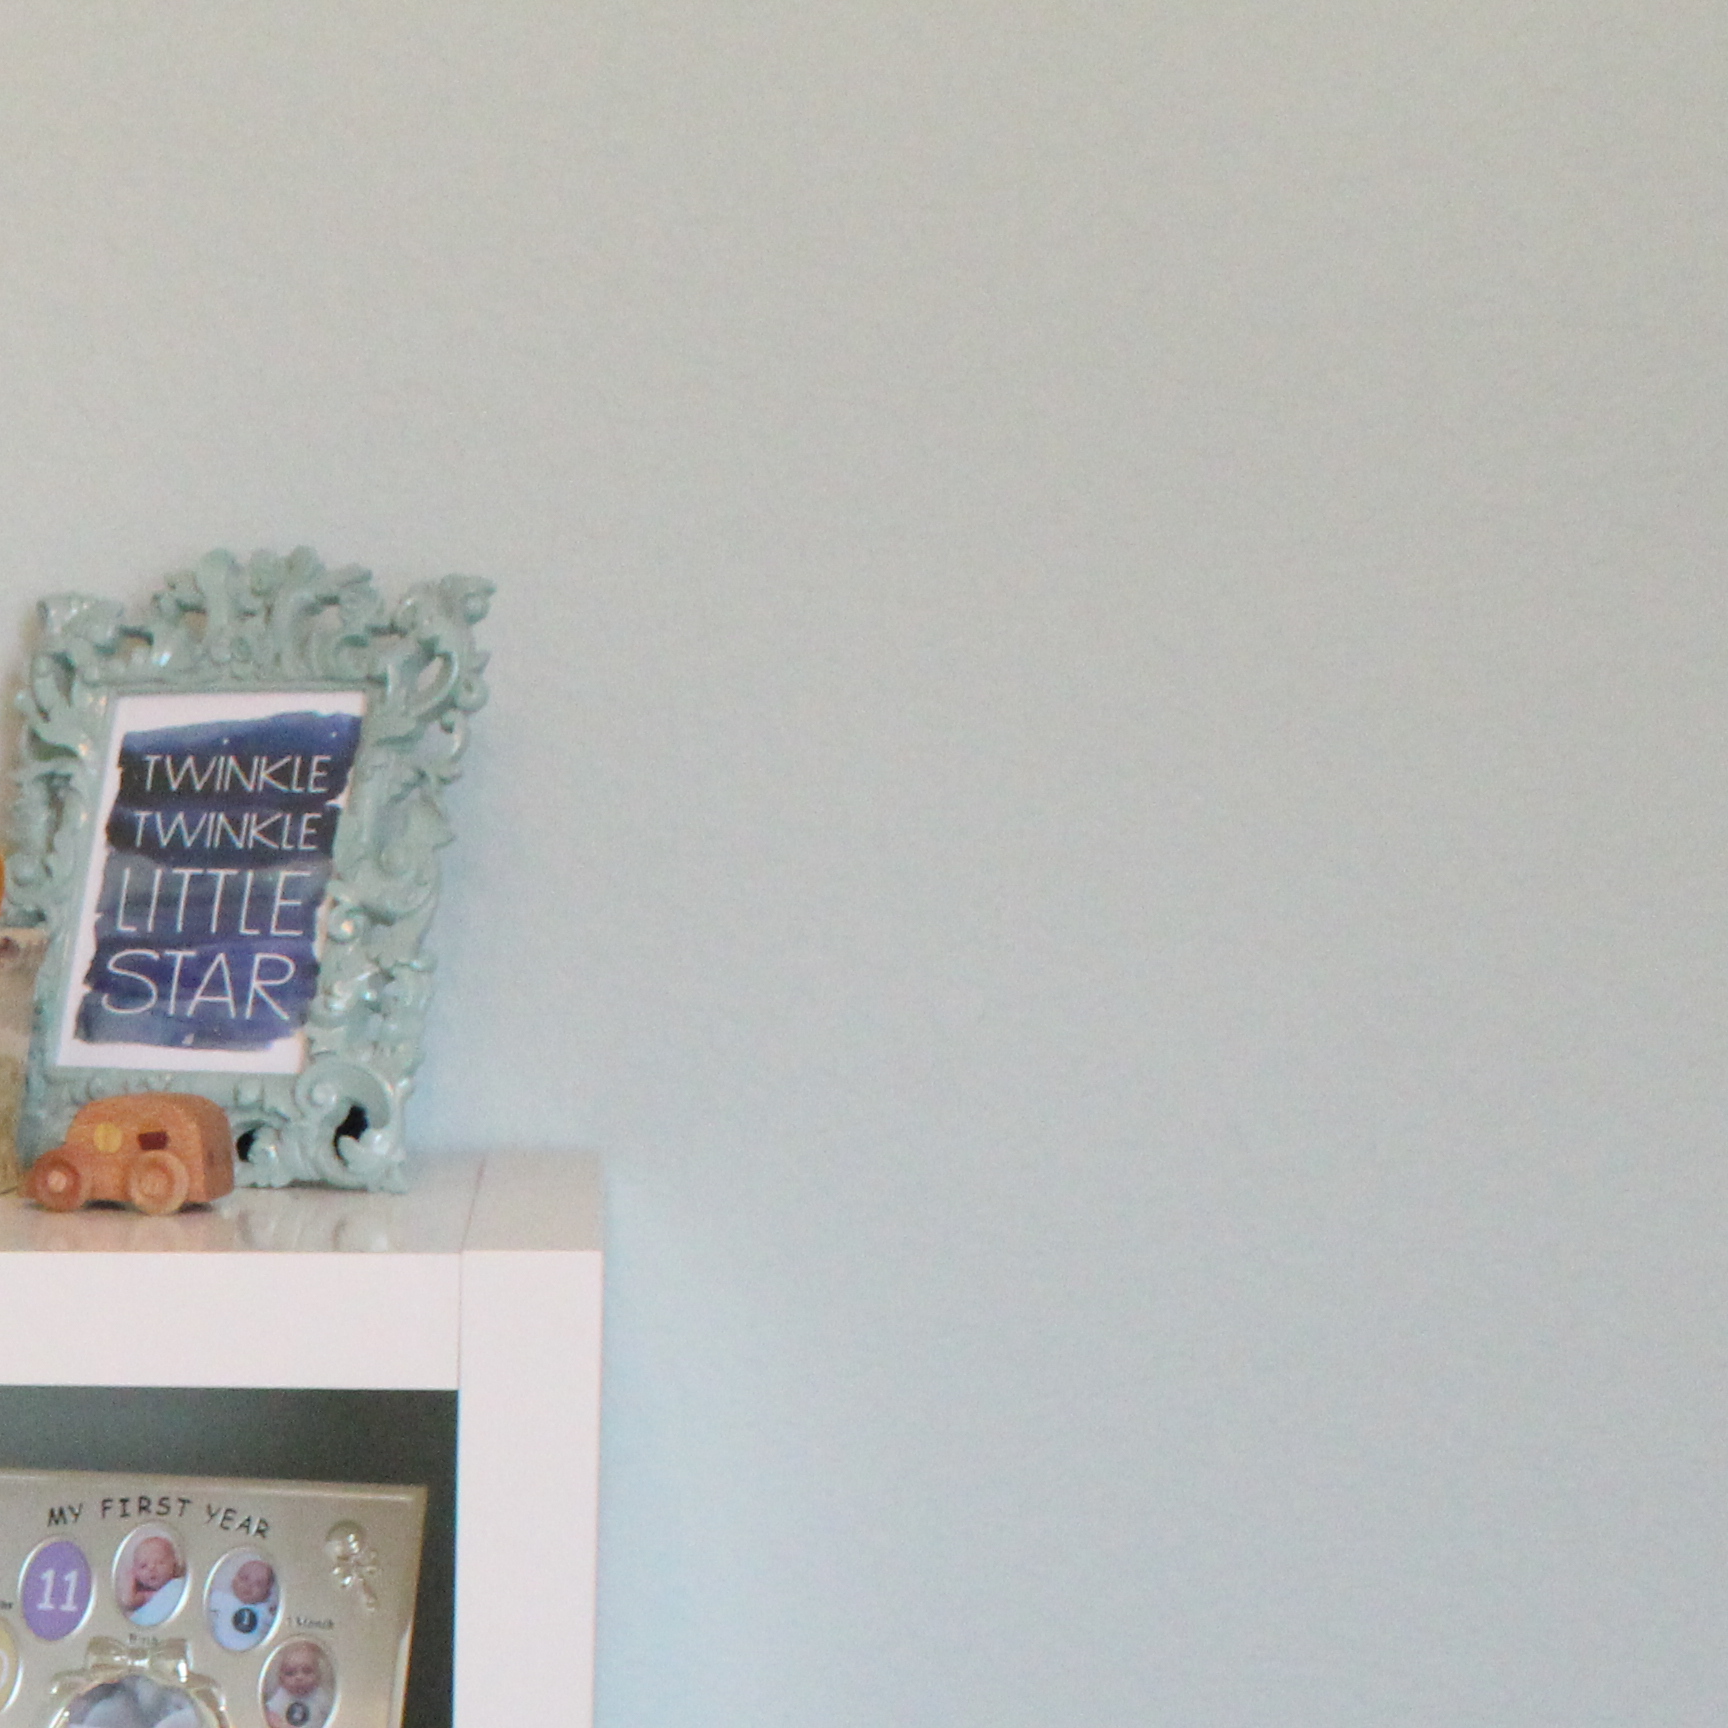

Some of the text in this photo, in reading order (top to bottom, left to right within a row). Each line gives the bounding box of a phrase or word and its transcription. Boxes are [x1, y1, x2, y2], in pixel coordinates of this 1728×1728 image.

[144, 755, 332, 794] TWINKLE
[133, 812, 322, 850] TWINKLE
[117, 867, 311, 936] LITTLE
[101, 948, 295, 1020] STAR
[47, 1495, 272, 1540] MY FIRST YEAR
[37, 1567, 81, 1612] 11
